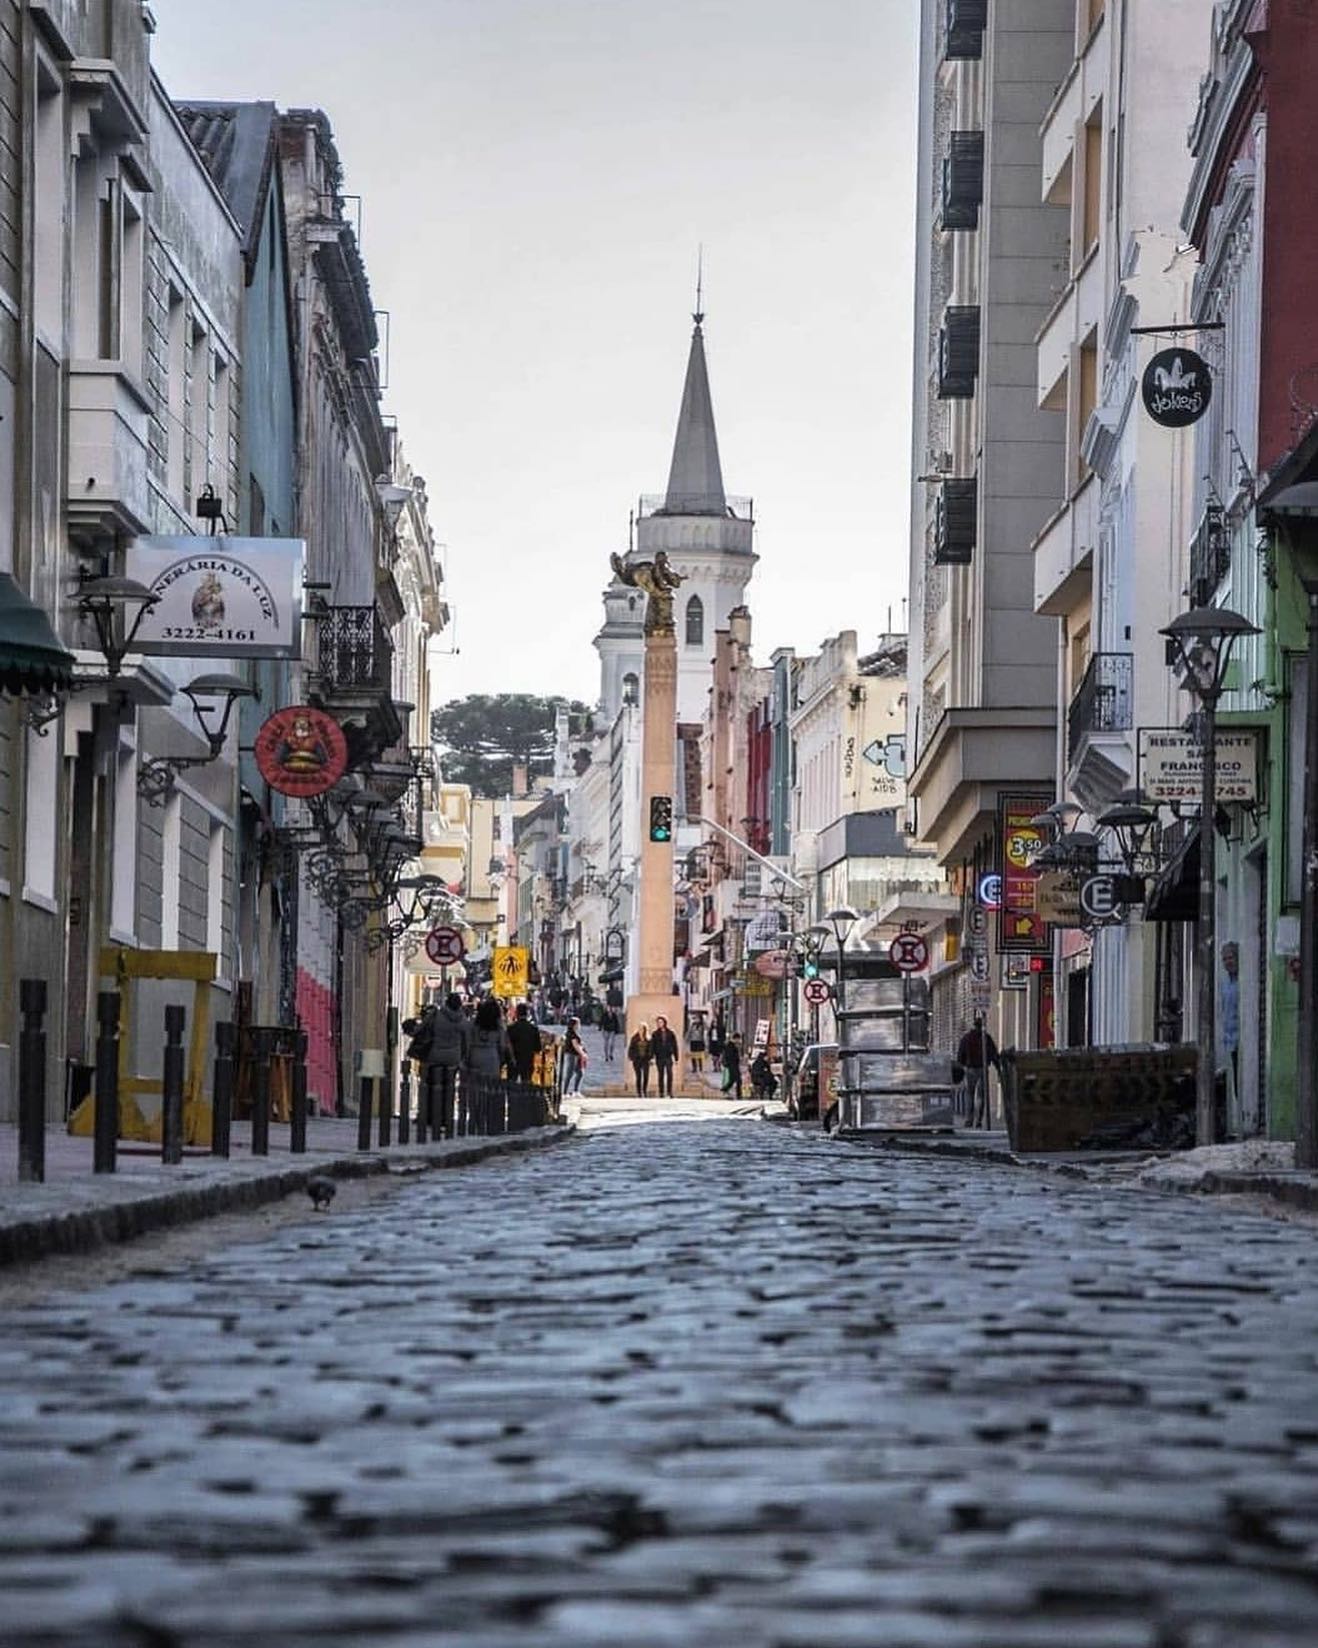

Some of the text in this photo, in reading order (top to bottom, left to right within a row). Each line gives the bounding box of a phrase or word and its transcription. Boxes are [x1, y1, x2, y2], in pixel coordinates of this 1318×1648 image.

[146, 561, 273, 620] FNERÁRIA DA LUZ
[161, 627, 256, 641] 3222-4161
[1155, 786, 1247, 797] 3224-745
[1091, 882, 1113, 910] E
